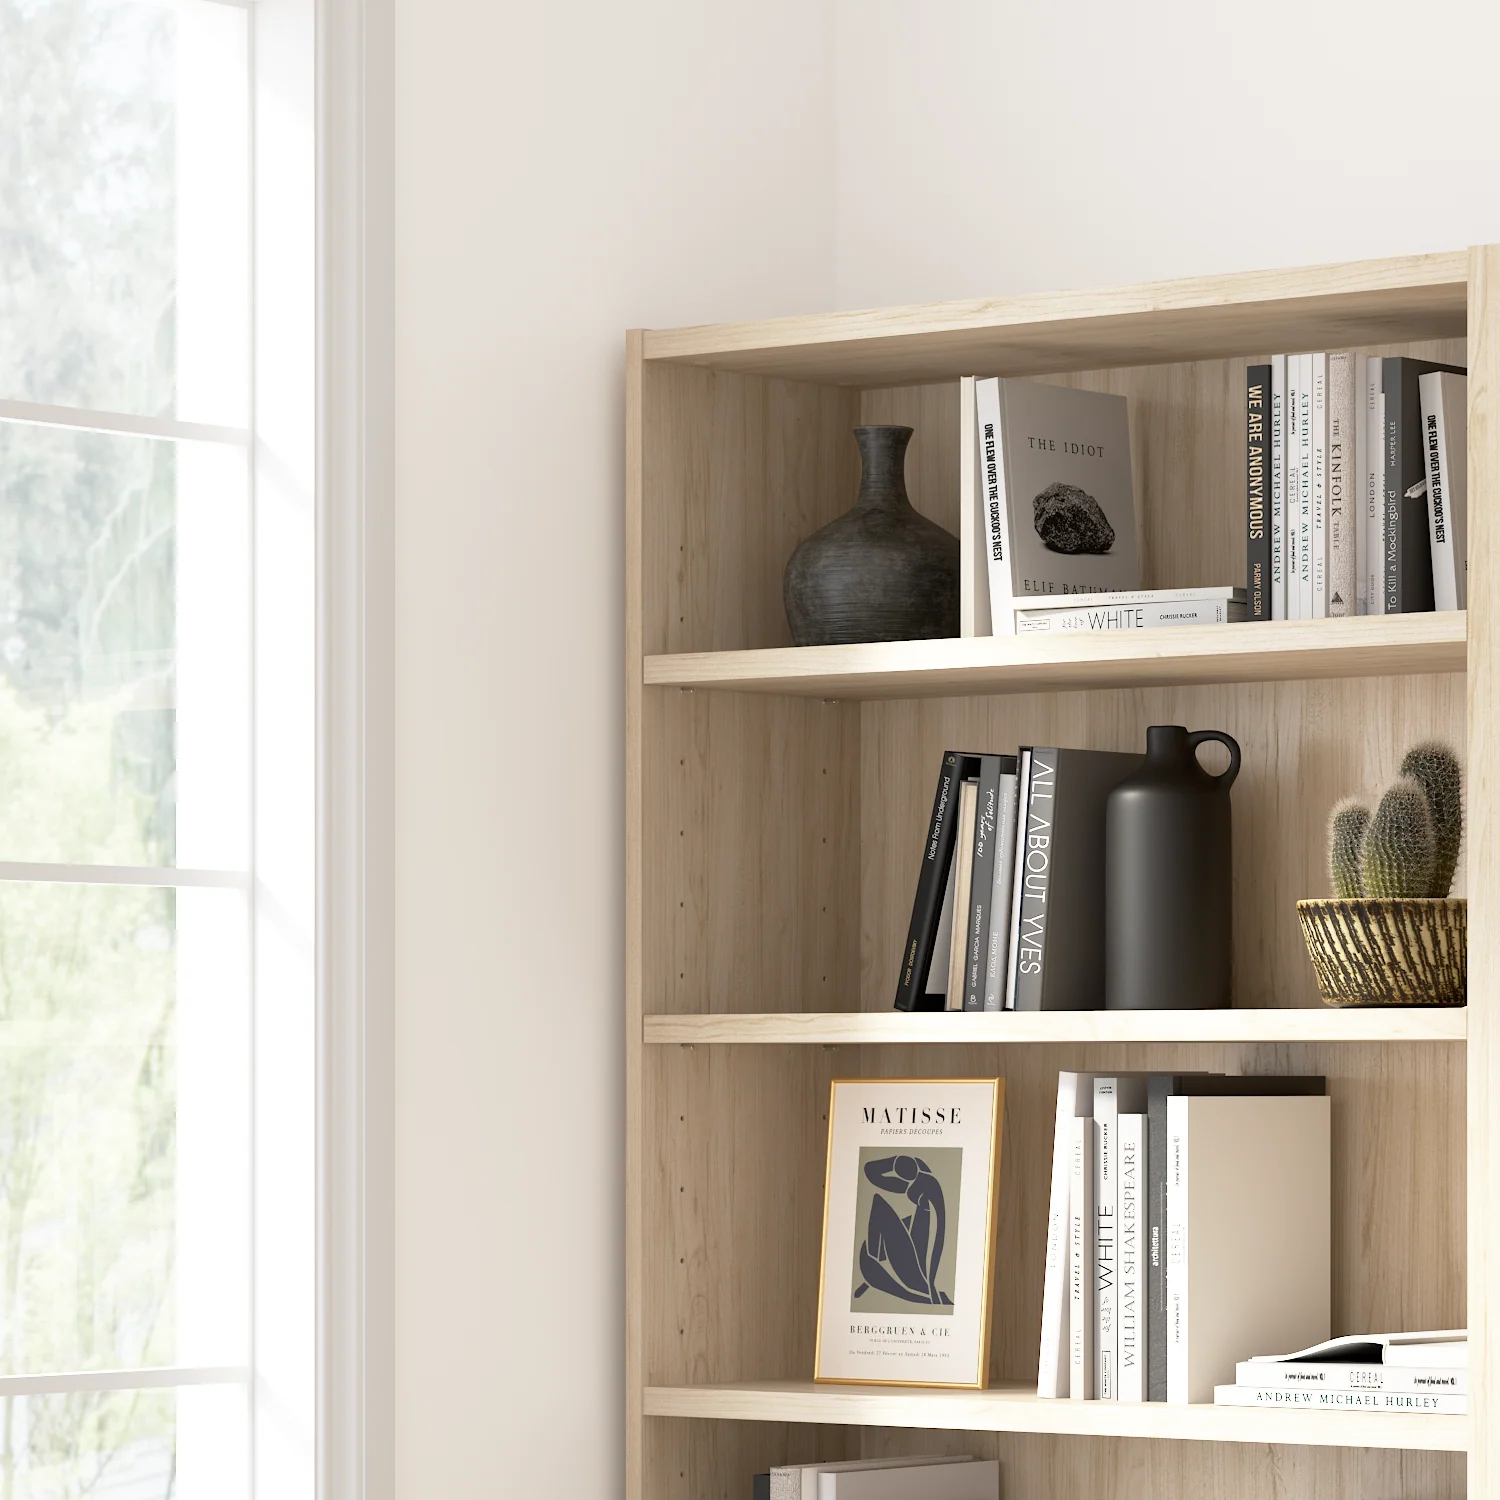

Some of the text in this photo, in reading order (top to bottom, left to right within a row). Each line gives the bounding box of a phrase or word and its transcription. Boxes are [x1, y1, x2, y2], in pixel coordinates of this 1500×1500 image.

[1028, 437, 1104, 458] THE IDIOT
[1248, 384, 1264, 540] WE ARE ANONYMOUS
[1332, 444, 1342, 517] KINFOLK
[1388, 490, 1398, 611] To Kill Mockingbird
[1024, 579, 1054, 593] ELIF
[1254, 563, 1262, 616] PARMY OLSON
[1087, 609, 1143, 630] WHITE
[928, 776, 951, 861] Notes From Underground
[1019, 758, 1054, 974] ALL ABOUT YVES
[861, 1107, 961, 1124] MATISSE
[1098, 1206, 1113, 1291] WHITE
[1124, 1142, 1136, 1368] WILLIAM SHAKESPEARE
[850, 1325, 914, 1335] BERGGRUEN
[1256, 1392, 1438, 1408] ANDREW MICHAEL HURLEY
[1350, 1371, 1384, 1384] CEREAL
